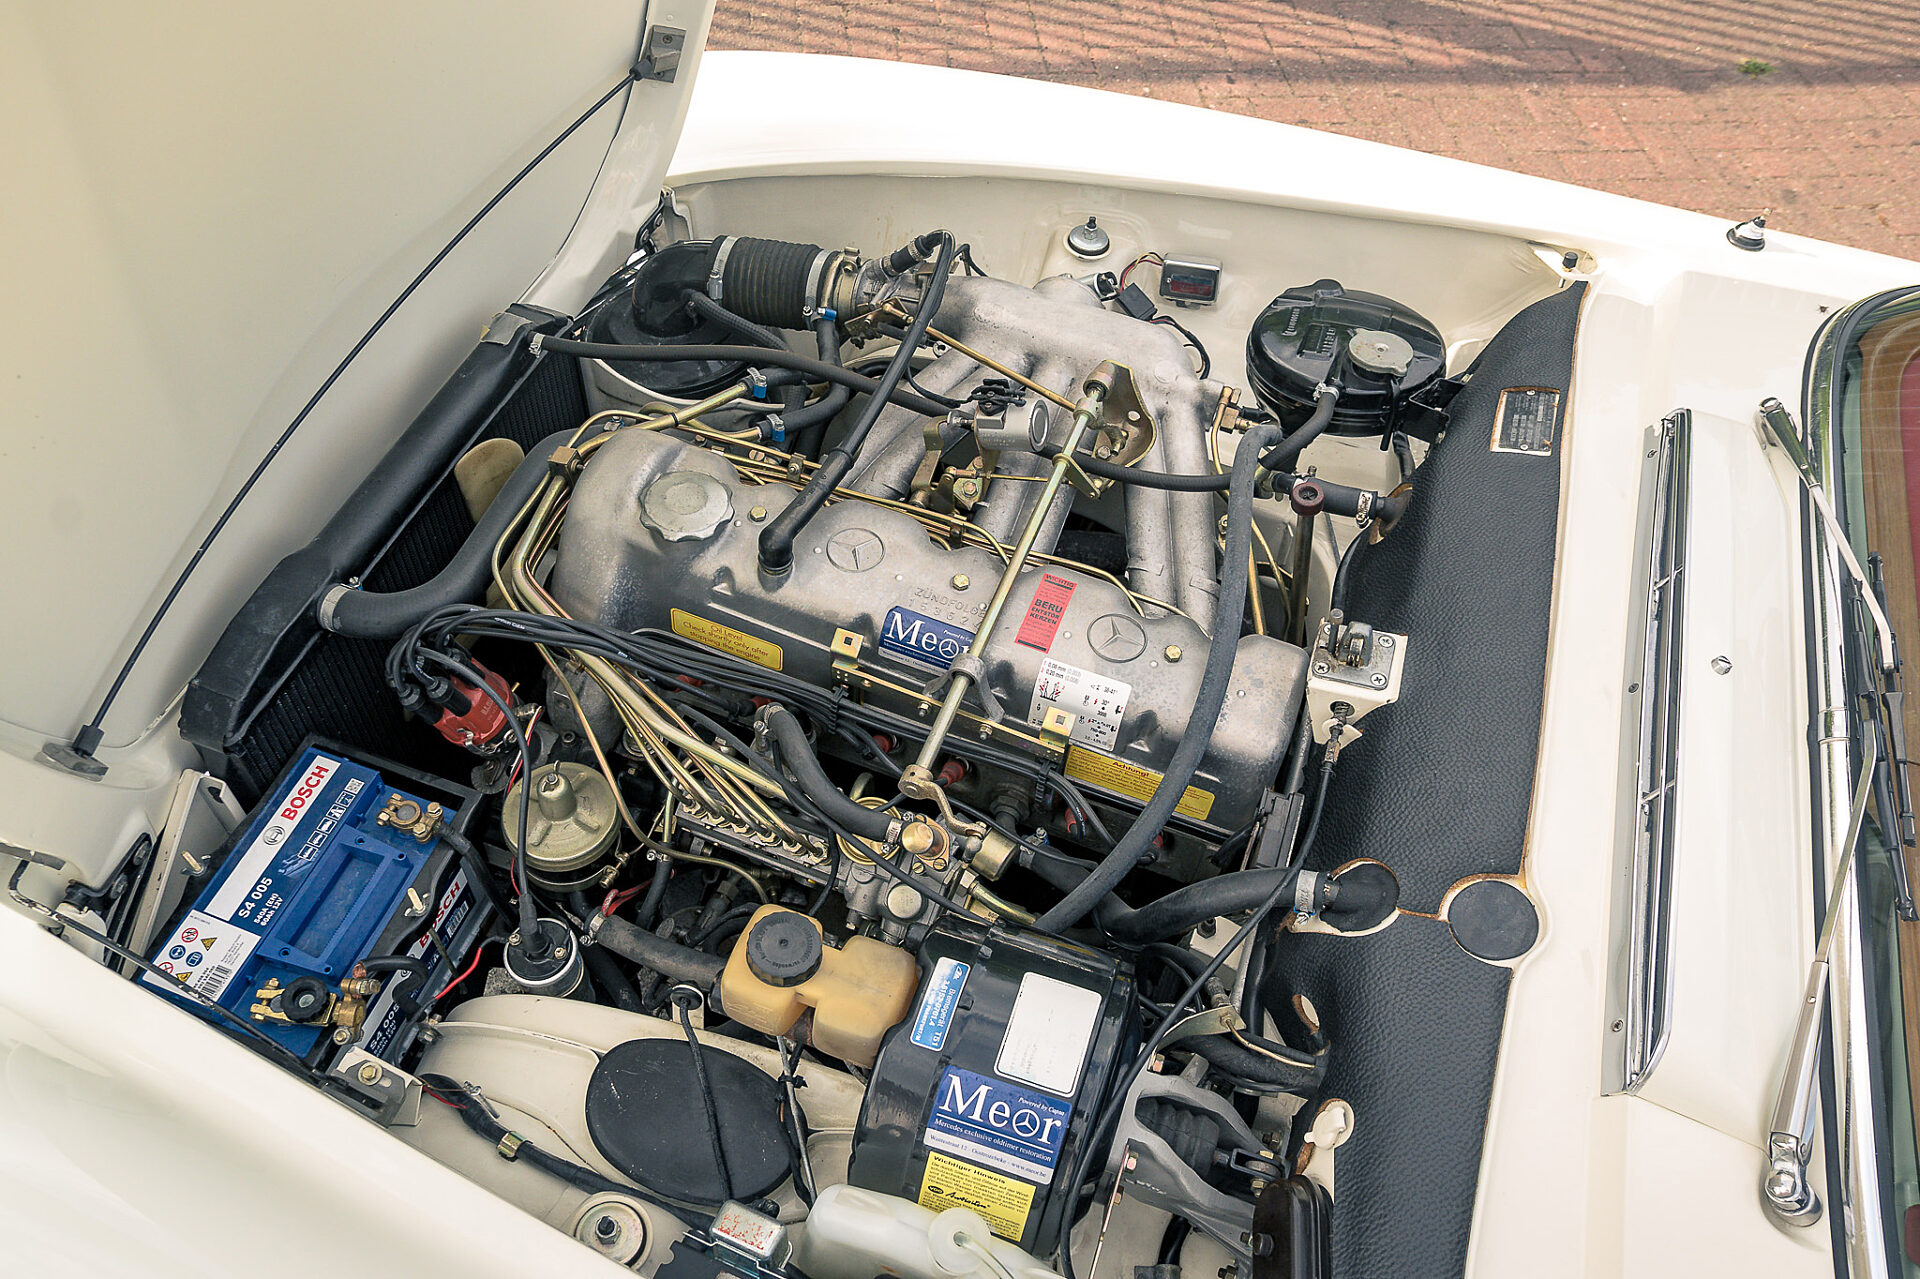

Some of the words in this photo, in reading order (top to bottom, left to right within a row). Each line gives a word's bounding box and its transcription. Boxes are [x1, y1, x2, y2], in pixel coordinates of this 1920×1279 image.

[1034, 598, 1063, 613] BERU
[1029, 612, 1057, 624] KERZEN
[682, 620, 706, 634] Check
[707, 629, 732, 644] shortly
[733, 640, 749, 651] only
[751, 645, 768, 657] after
[710, 624, 723, 634] Oil
[723, 629, 743, 642] Level
[722, 642, 734, 650] the
[1112, 760, 1149, 777] Achtung!
[279, 762, 330, 821] BOSCH
[237, 898, 257, 919] S4
[250, 875, 274, 900] 005
[936, 987, 955, 1027] Bremsgerät
[368, 1029, 383, 1050] S4
[930, 1031, 942, 1046] T51
[1017, 1096, 1041, 1109] Powered
[934, 1117, 963, 1133] Mercedes
[963, 1128, 992, 1142] exclusive
[992, 1137, 1018, 1151] oldtimer
[1019, 1147, 1051, 1162] restoration
[933, 1155, 971, 1172] Wichtiger
[973, 1169, 1006, 1184] Hinweis
